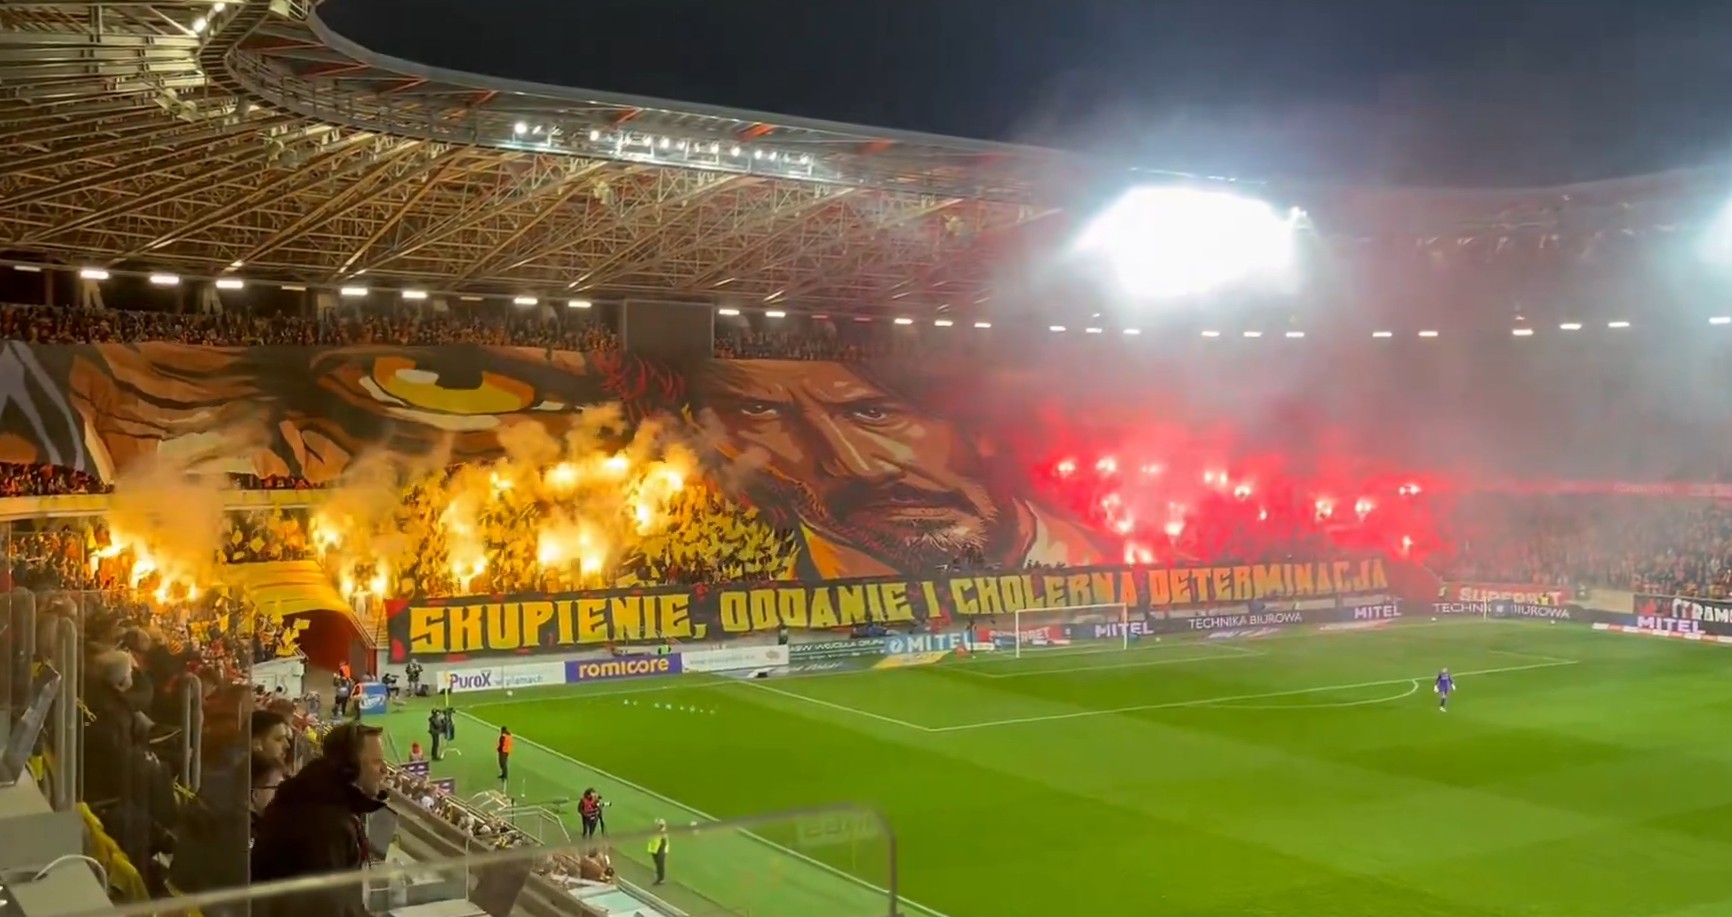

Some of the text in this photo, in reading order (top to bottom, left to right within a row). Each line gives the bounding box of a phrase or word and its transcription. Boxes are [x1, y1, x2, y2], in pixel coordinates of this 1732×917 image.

[408, 559, 1388, 654] SKUPIENIE, ODDANIE I CHOLERNA DETERMINACJA
[1354, 604, 1402, 619] MITEL
[1188, 611, 1303, 630] TECHNIKA BIUROWA
[1637, 616, 1706, 634] MITEL
[1095, 622, 1155, 638] MITEL
[907, 632, 974, 653] MITEL
[578, 658, 669, 678] romicore
[450, 672, 492, 689] PuroX
